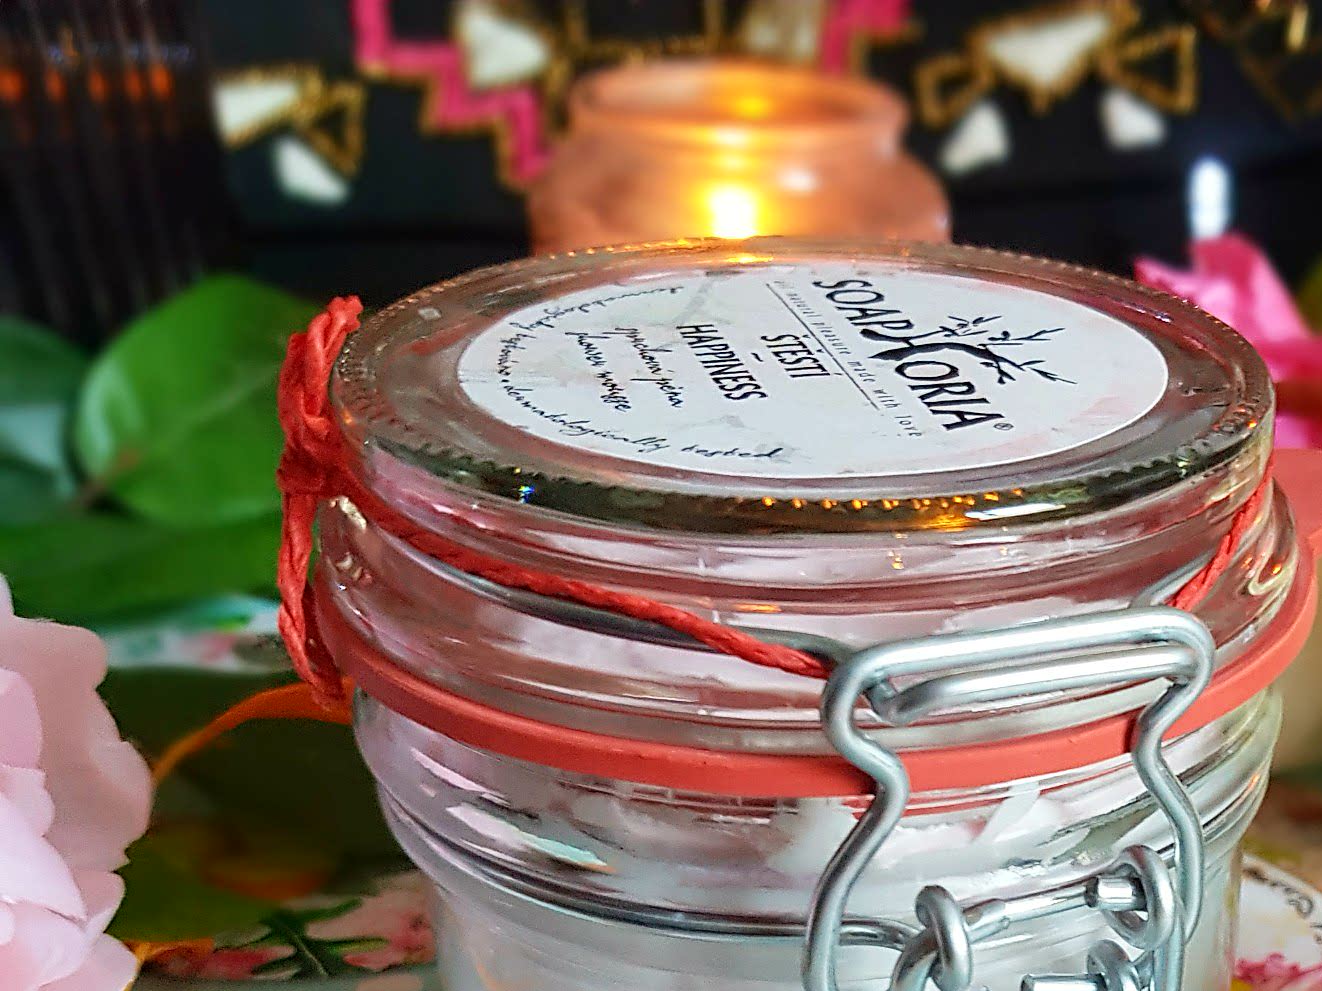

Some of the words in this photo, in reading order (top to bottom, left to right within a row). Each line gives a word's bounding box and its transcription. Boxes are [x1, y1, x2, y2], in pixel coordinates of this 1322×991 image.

[676, 323, 768, 401] HAPPINESS
[847, 360, 877, 383] made
[873, 388, 901, 409] with
[895, 414, 923, 437] love
